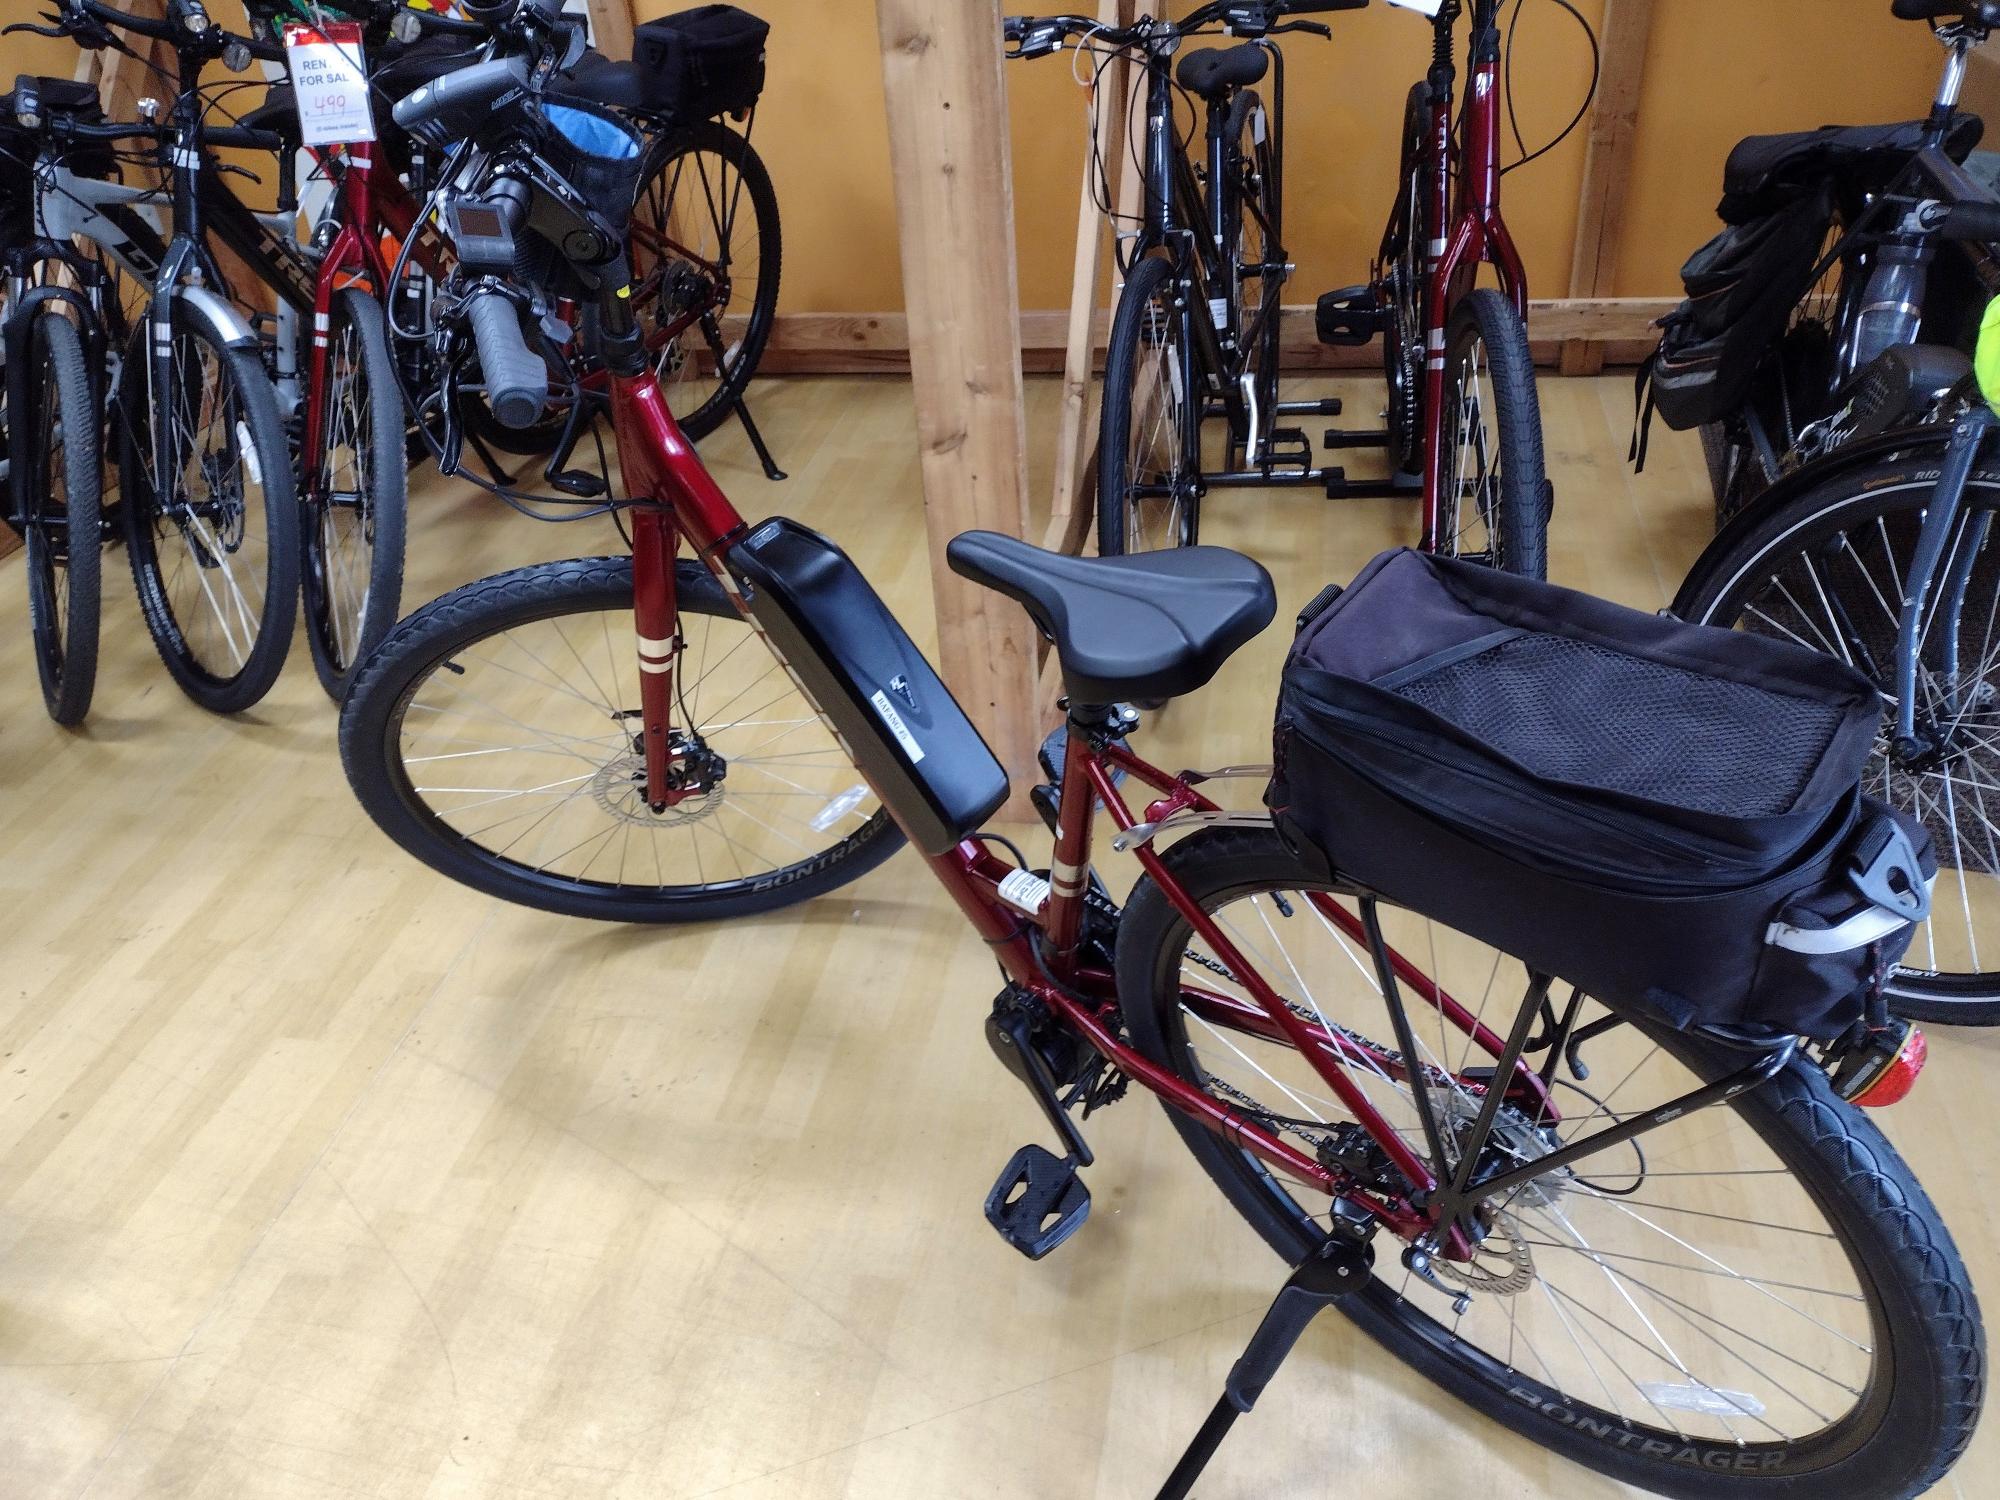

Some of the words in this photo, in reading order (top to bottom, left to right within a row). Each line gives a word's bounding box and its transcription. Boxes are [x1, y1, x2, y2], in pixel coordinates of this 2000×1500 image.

[299, 75, 324, 87] FOR
[326, 72, 352, 84] SAL
[314, 95, 346, 116] 499
[259, 228, 315, 301] TRE
[1914, 469, 1941, 480] RID
[751, 809, 889, 892] BONTRAGE
[1506, 1386, 1788, 1470] BONTRAGER
